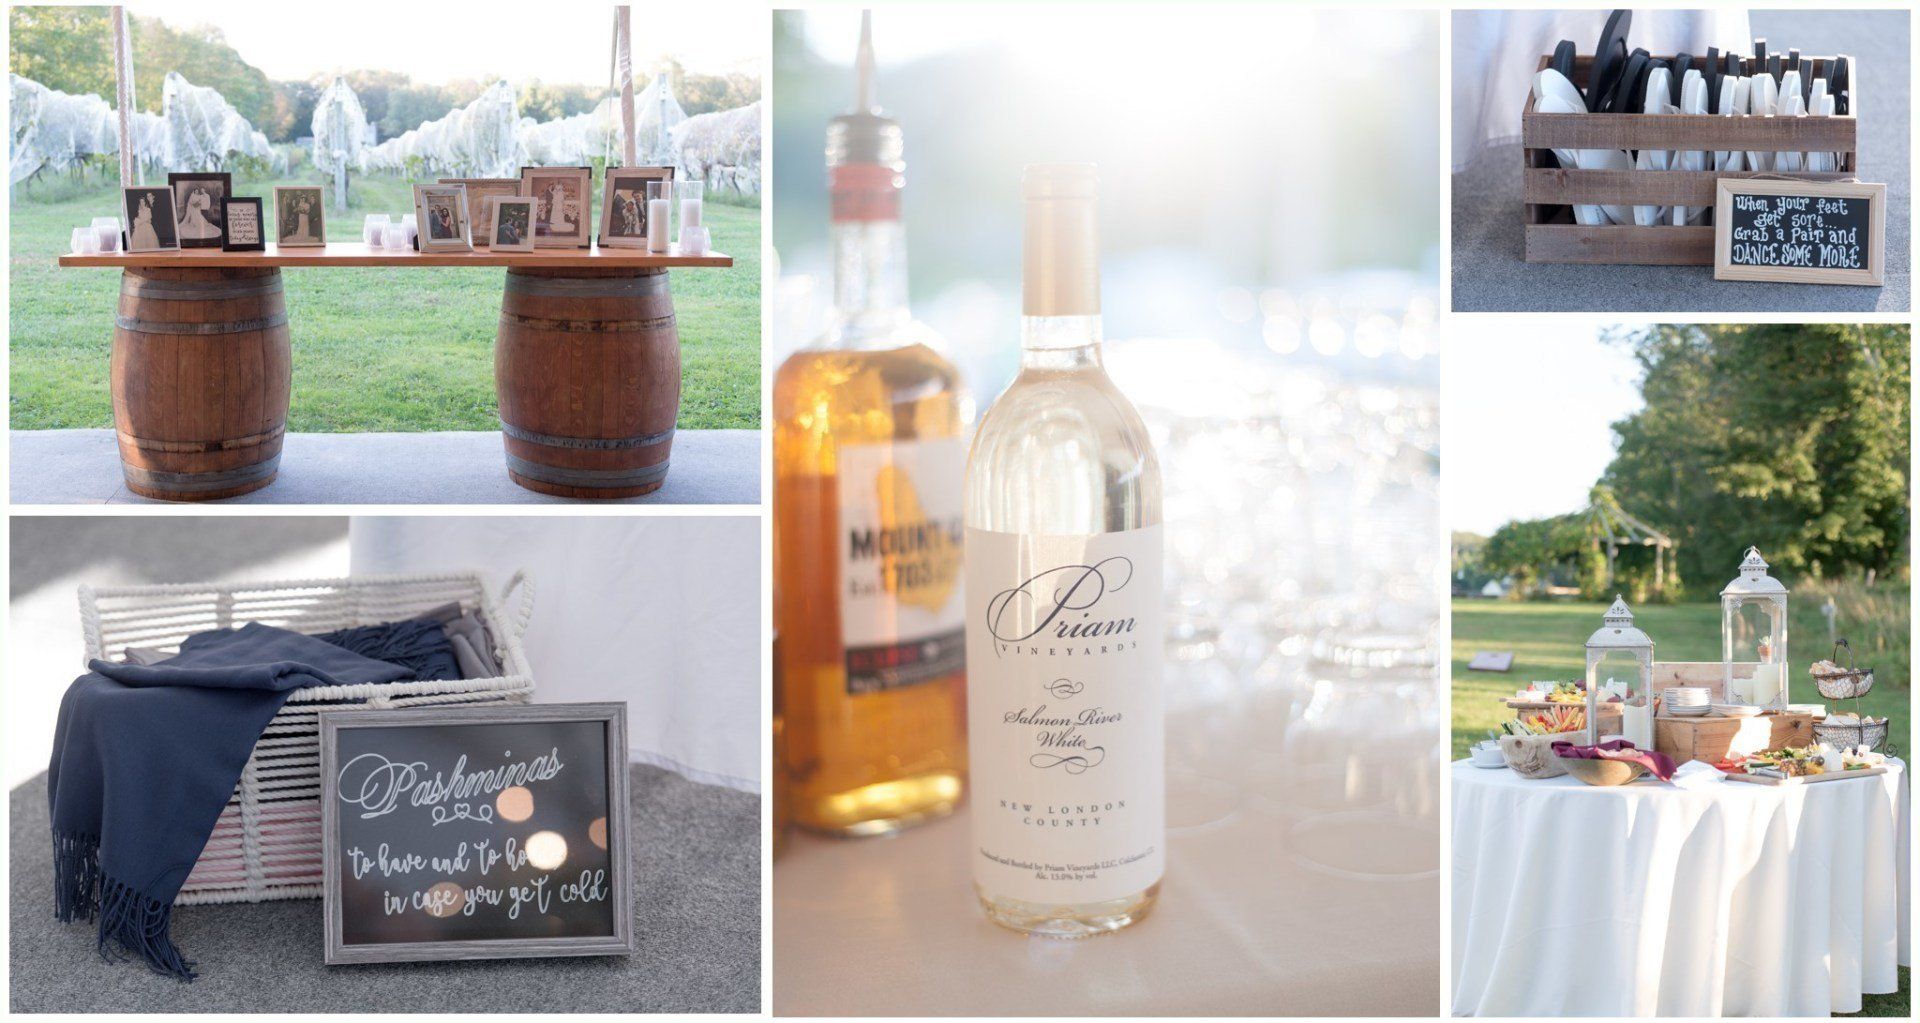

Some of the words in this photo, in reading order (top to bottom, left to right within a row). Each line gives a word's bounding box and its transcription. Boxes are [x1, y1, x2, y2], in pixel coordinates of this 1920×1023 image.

[1735, 196, 1769, 212] When
[1776, 196, 1810, 216] your
[1815, 198, 1849, 215] feet
[1753, 210, 1781, 228] get
[1733, 226, 1769, 241] Grab
[1775, 228, 1785, 242] a
[1829, 227, 1858, 245] and
[1733, 242, 1780, 265] DANCE
[850, 519, 942, 560] MOUNT
[986, 556, 1137, 659] Priam
[1001, 641, 1137, 657] VINEYARDS
[1003, 704, 1072, 727] Salmon
[1073, 706, 1123, 727] River
[1036, 727, 1090, 753] White
[338, 747, 564, 819] Pashminas
[1000, 799, 1033, 813] NEW
[1048, 800, 1127, 815] LONDON
[1023, 816, 1102, 828] COUNTY
[347, 846, 375, 880] to
[378, 843, 427, 878] have
[432, 842, 471, 876] and
[474, 838, 501, 876] to
[384, 890, 408, 916] in
[412, 889, 458, 918] case
[464, 885, 504, 917] you
[509, 874, 551, 920] get
[560, 869, 609, 903] cold
